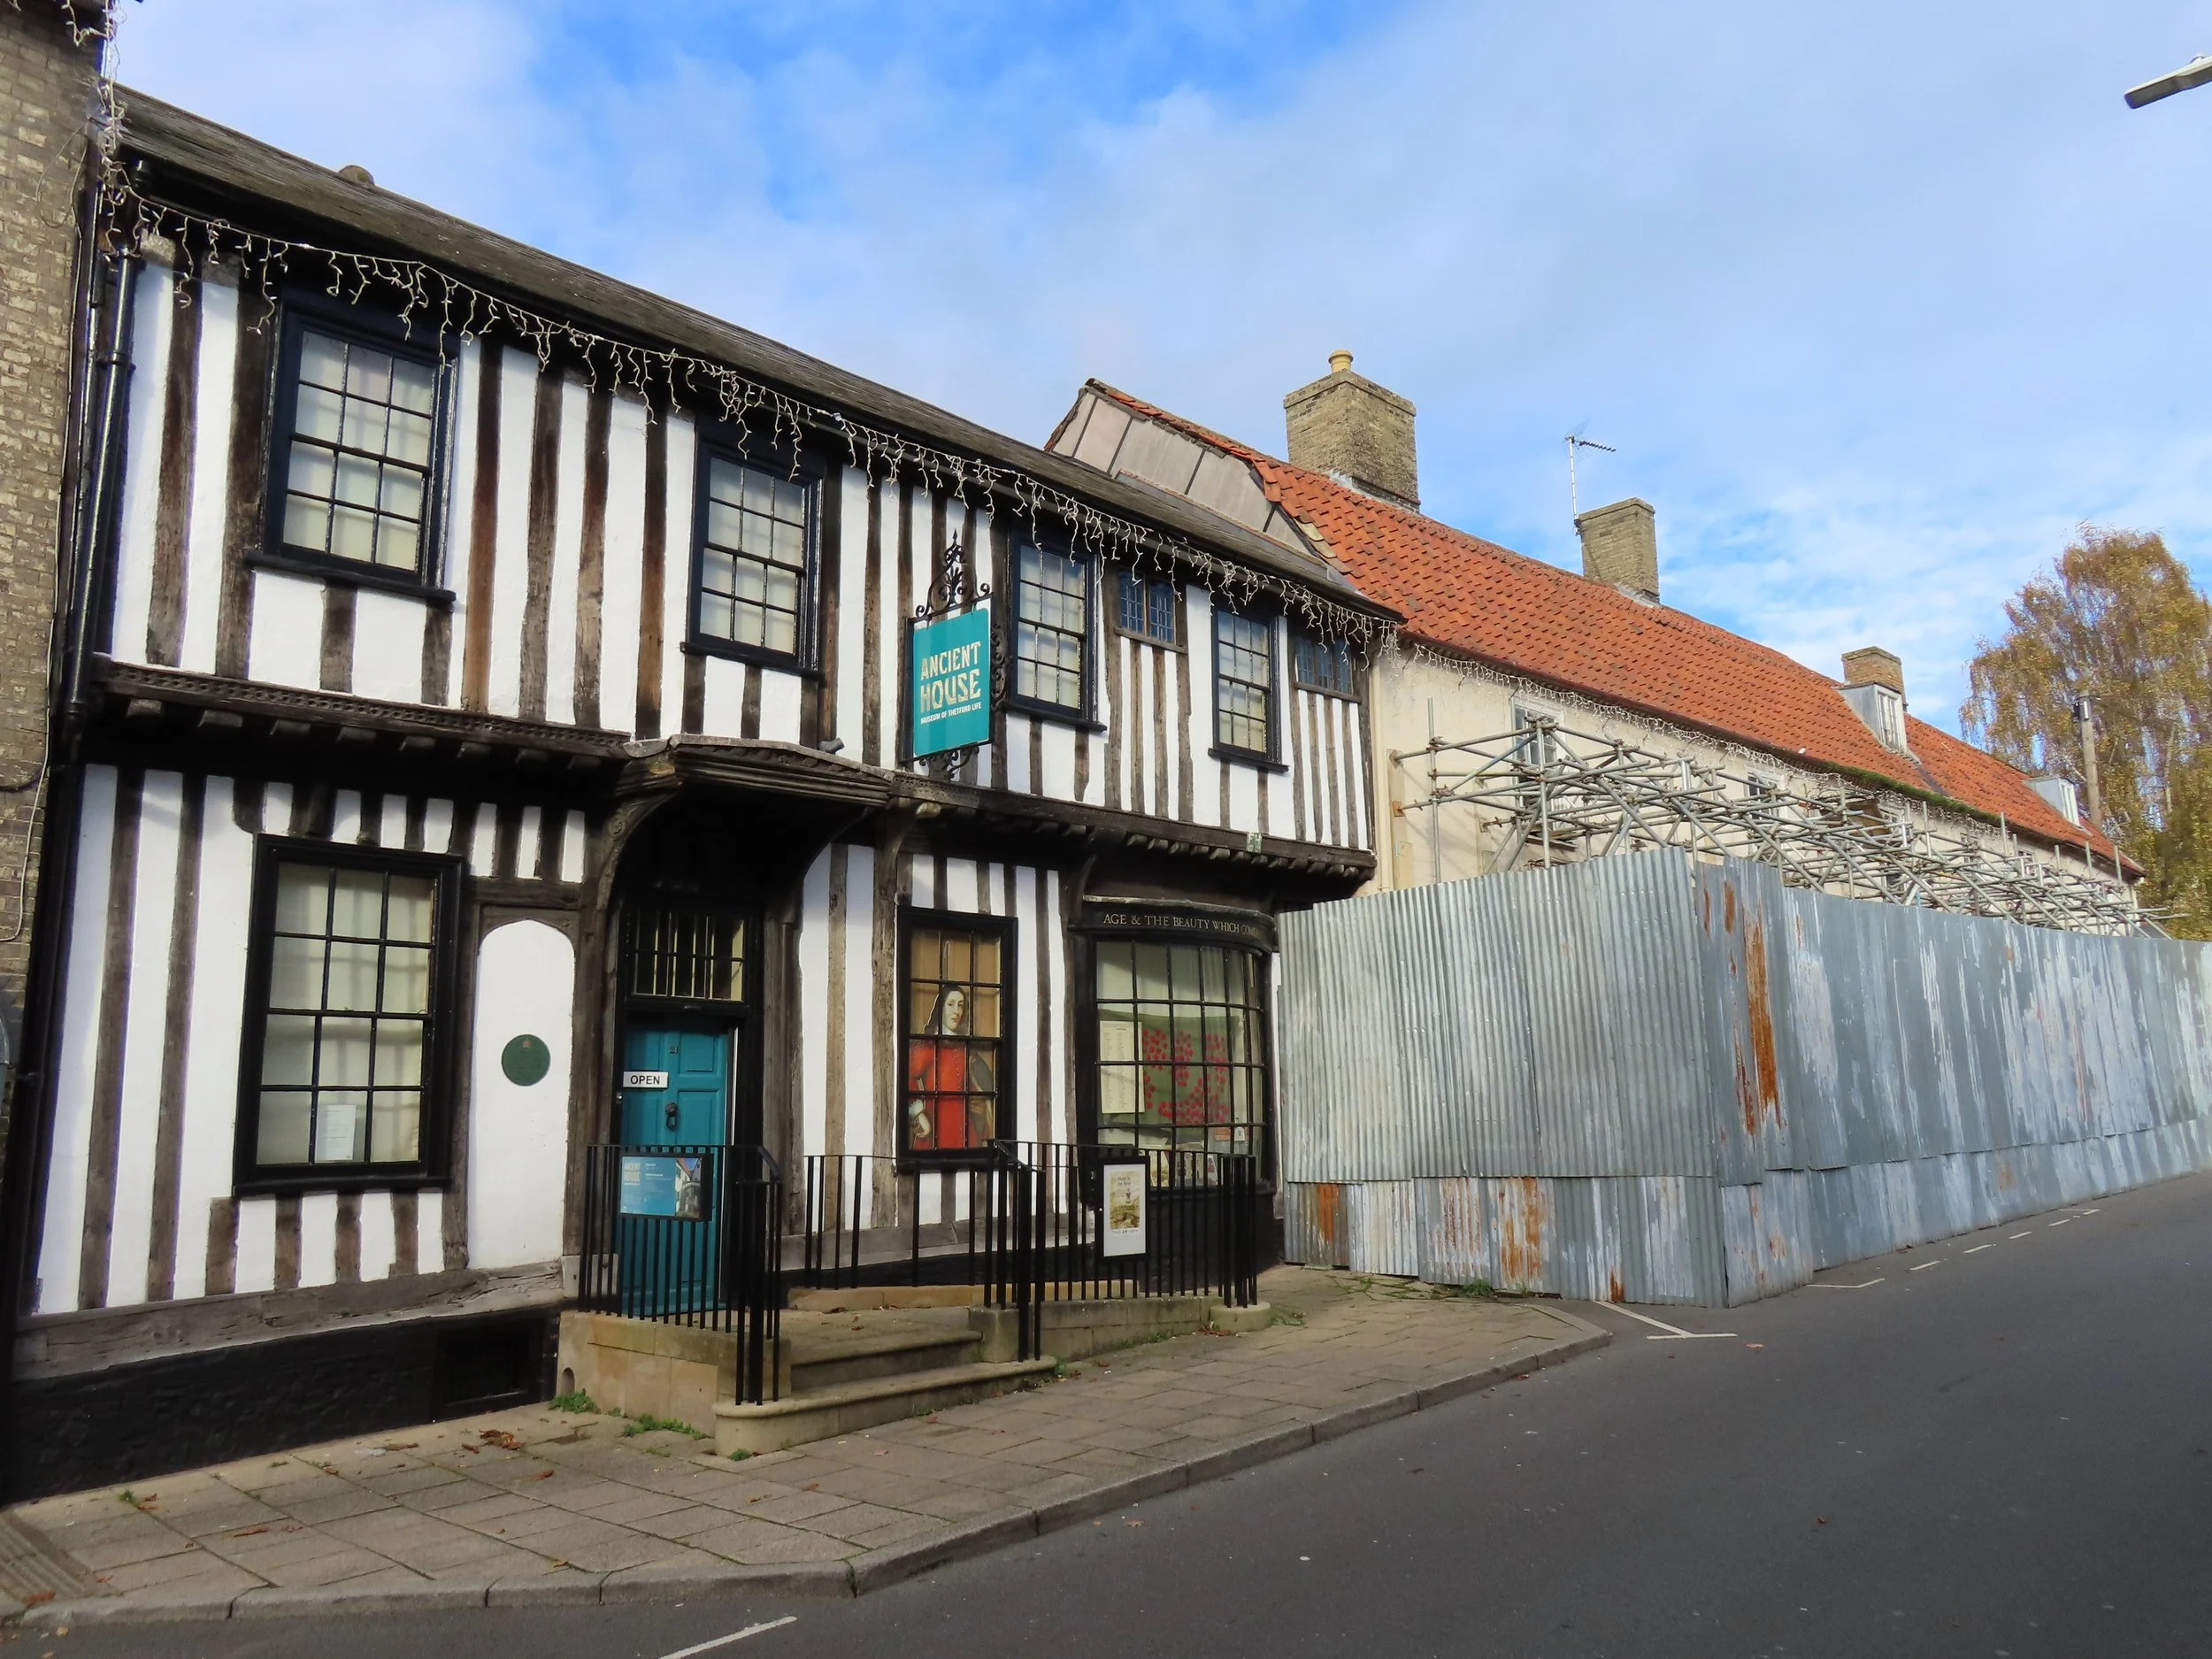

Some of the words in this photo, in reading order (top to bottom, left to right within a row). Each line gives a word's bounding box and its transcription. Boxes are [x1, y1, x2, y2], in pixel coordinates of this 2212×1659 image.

[921, 641, 980, 680] ANCIENT
[920, 669, 981, 712] HOUSE
[920, 713, 941, 724] MUSEUM
[949, 705, 971, 716] THETFORD
[972, 702, 981, 710] LIFE
[1103, 913, 1126, 925] AGE
[1131, 915, 1141, 926] &
[1144, 915, 1170, 926] THE
[1173, 917, 1210, 929] BEAUTY
[1211, 920, 1240, 933] WHICH
[630, 1075, 660, 1085] OPEN
